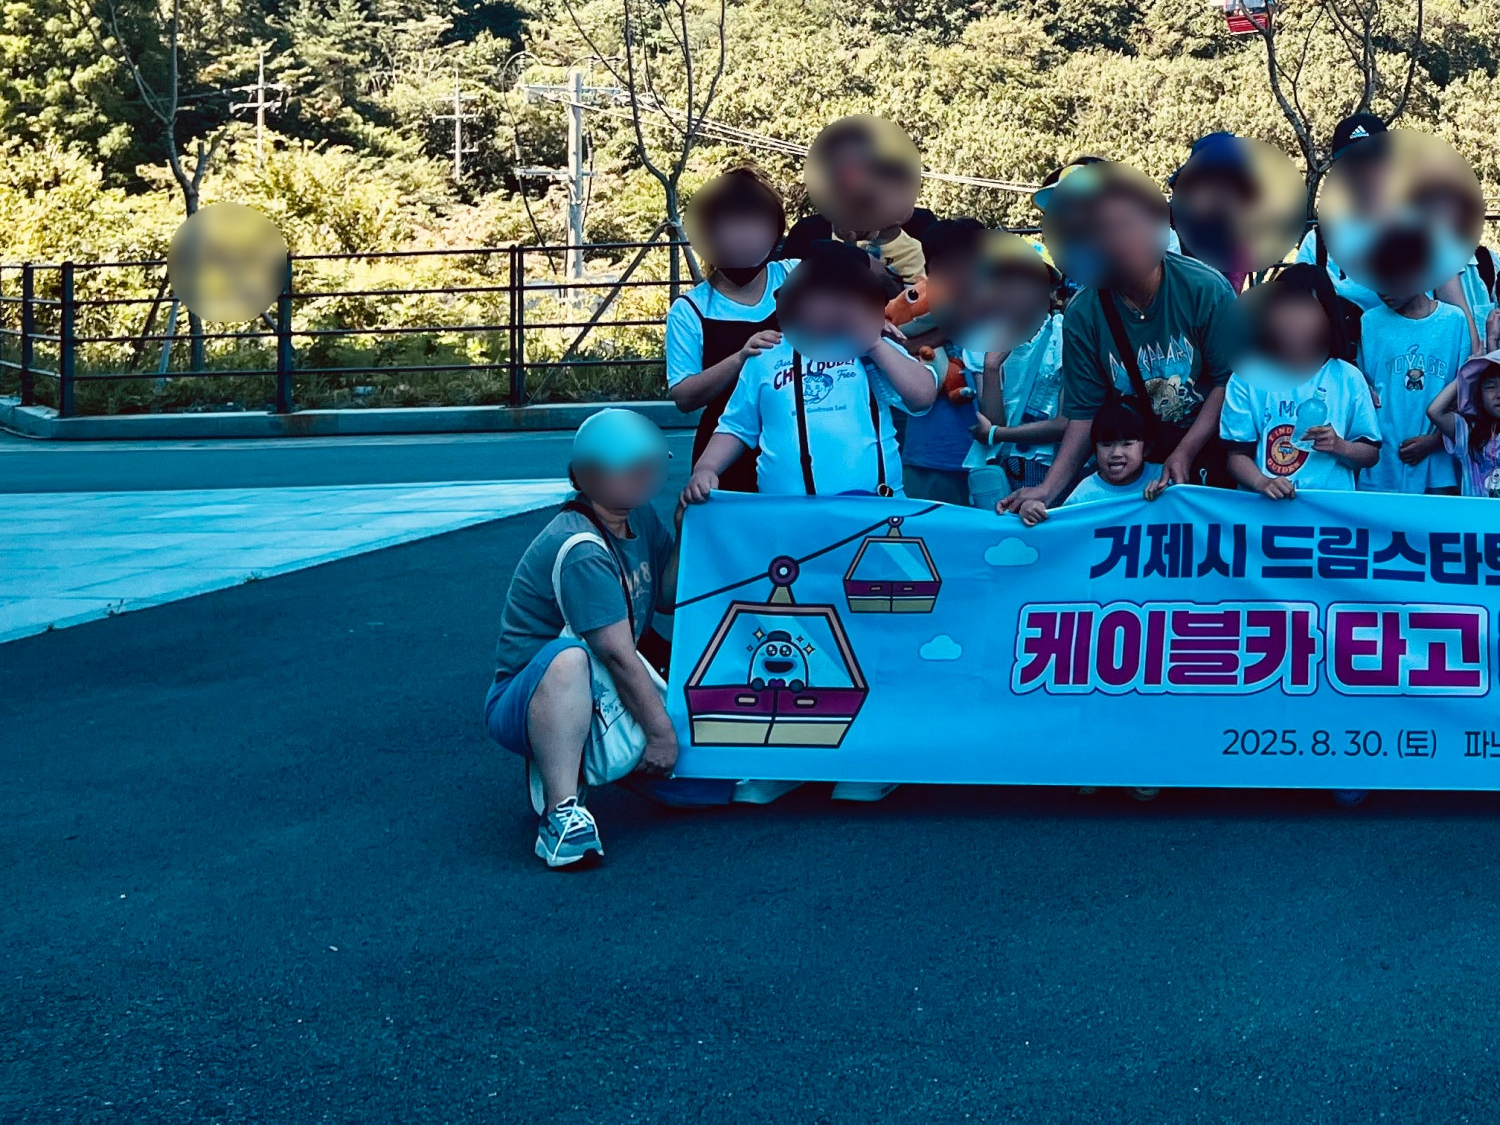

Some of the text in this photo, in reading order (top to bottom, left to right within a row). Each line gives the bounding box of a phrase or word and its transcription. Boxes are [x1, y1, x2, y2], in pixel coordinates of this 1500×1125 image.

[1089, 522, 1247, 579] 거제시
[1018, 609, 1316, 687] 케이블카
[1335, 611, 1481, 687] 타고
[1222, 729, 1304, 757] 2025.
[1310, 729, 1337, 757] 8.
[1343, 730, 1388, 757] 30.
[1396, 728, 1438, 760] (토)
